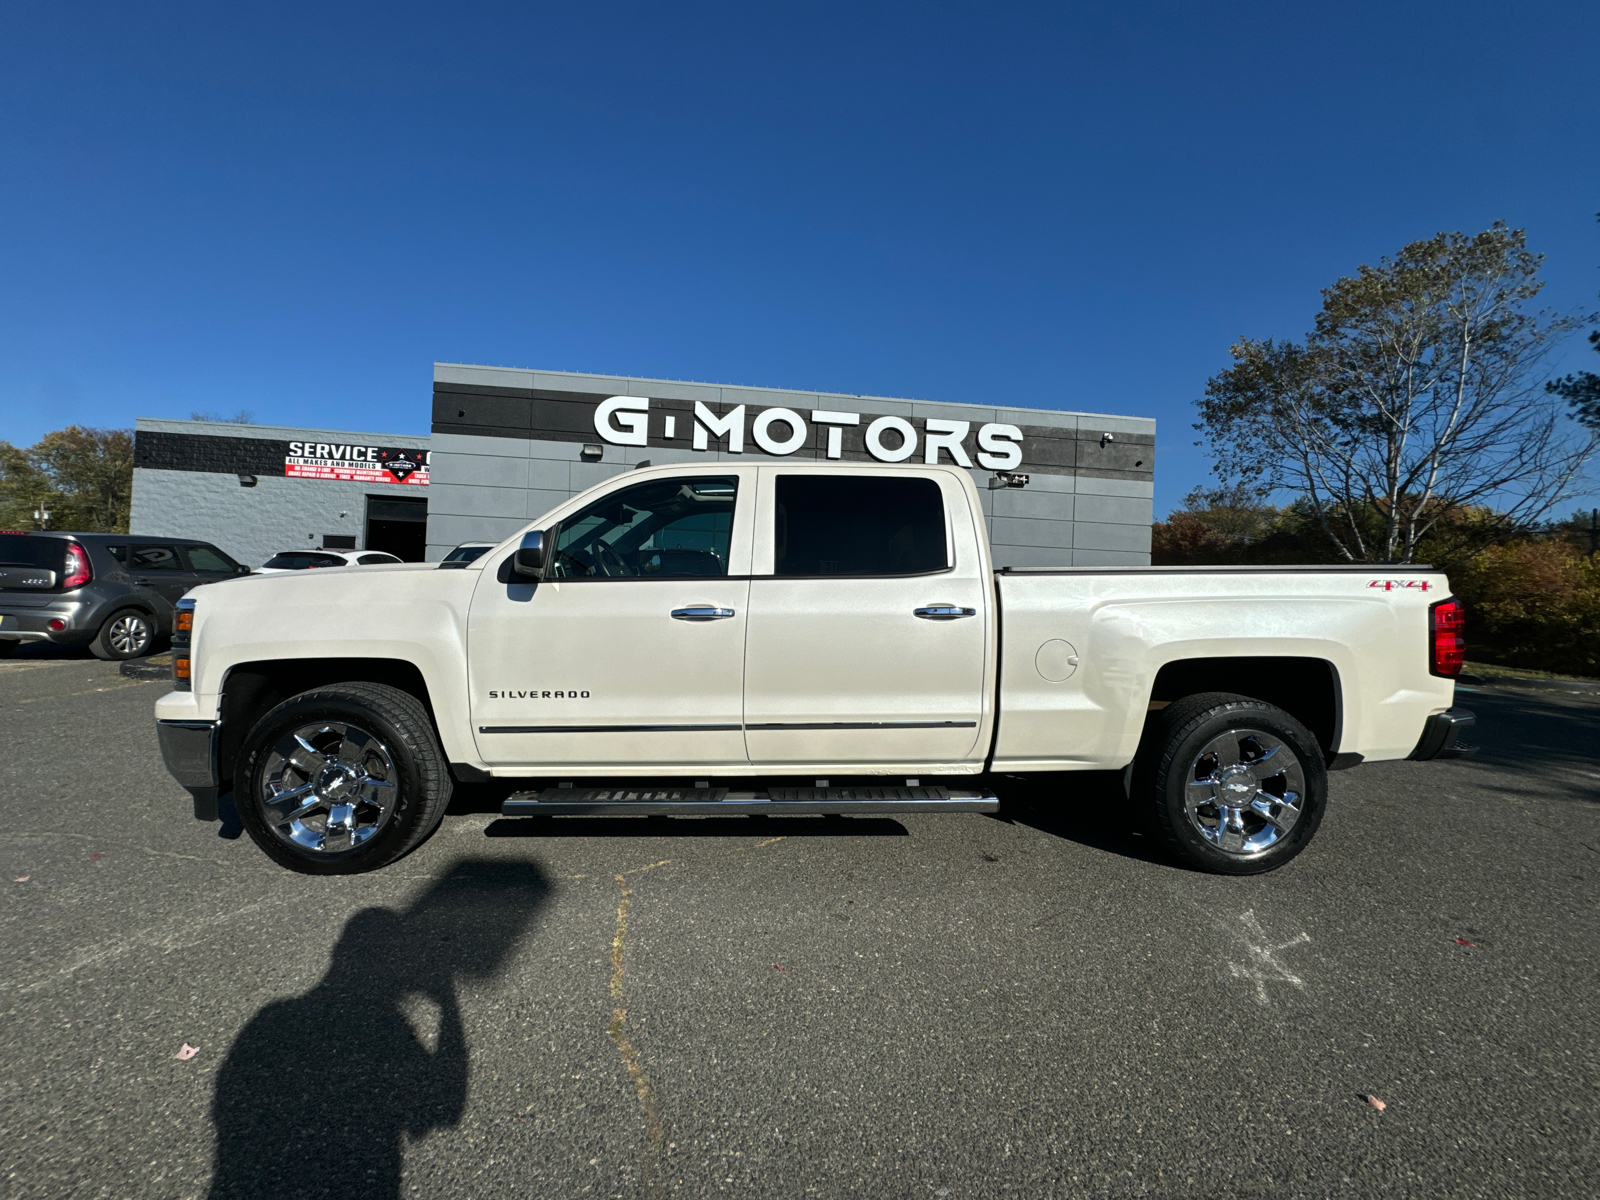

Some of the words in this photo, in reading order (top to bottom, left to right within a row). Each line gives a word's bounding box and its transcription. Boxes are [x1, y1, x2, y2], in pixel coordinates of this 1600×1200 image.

[289, 442, 379, 462] SERVICE
[288, 457, 300, 465] ALL
[303, 458, 328, 466] MAKES
[331, 460, 346, 468] AND
[348, 461, 377, 469] MODELS
[489, 690, 590, 698] SILVERADO
